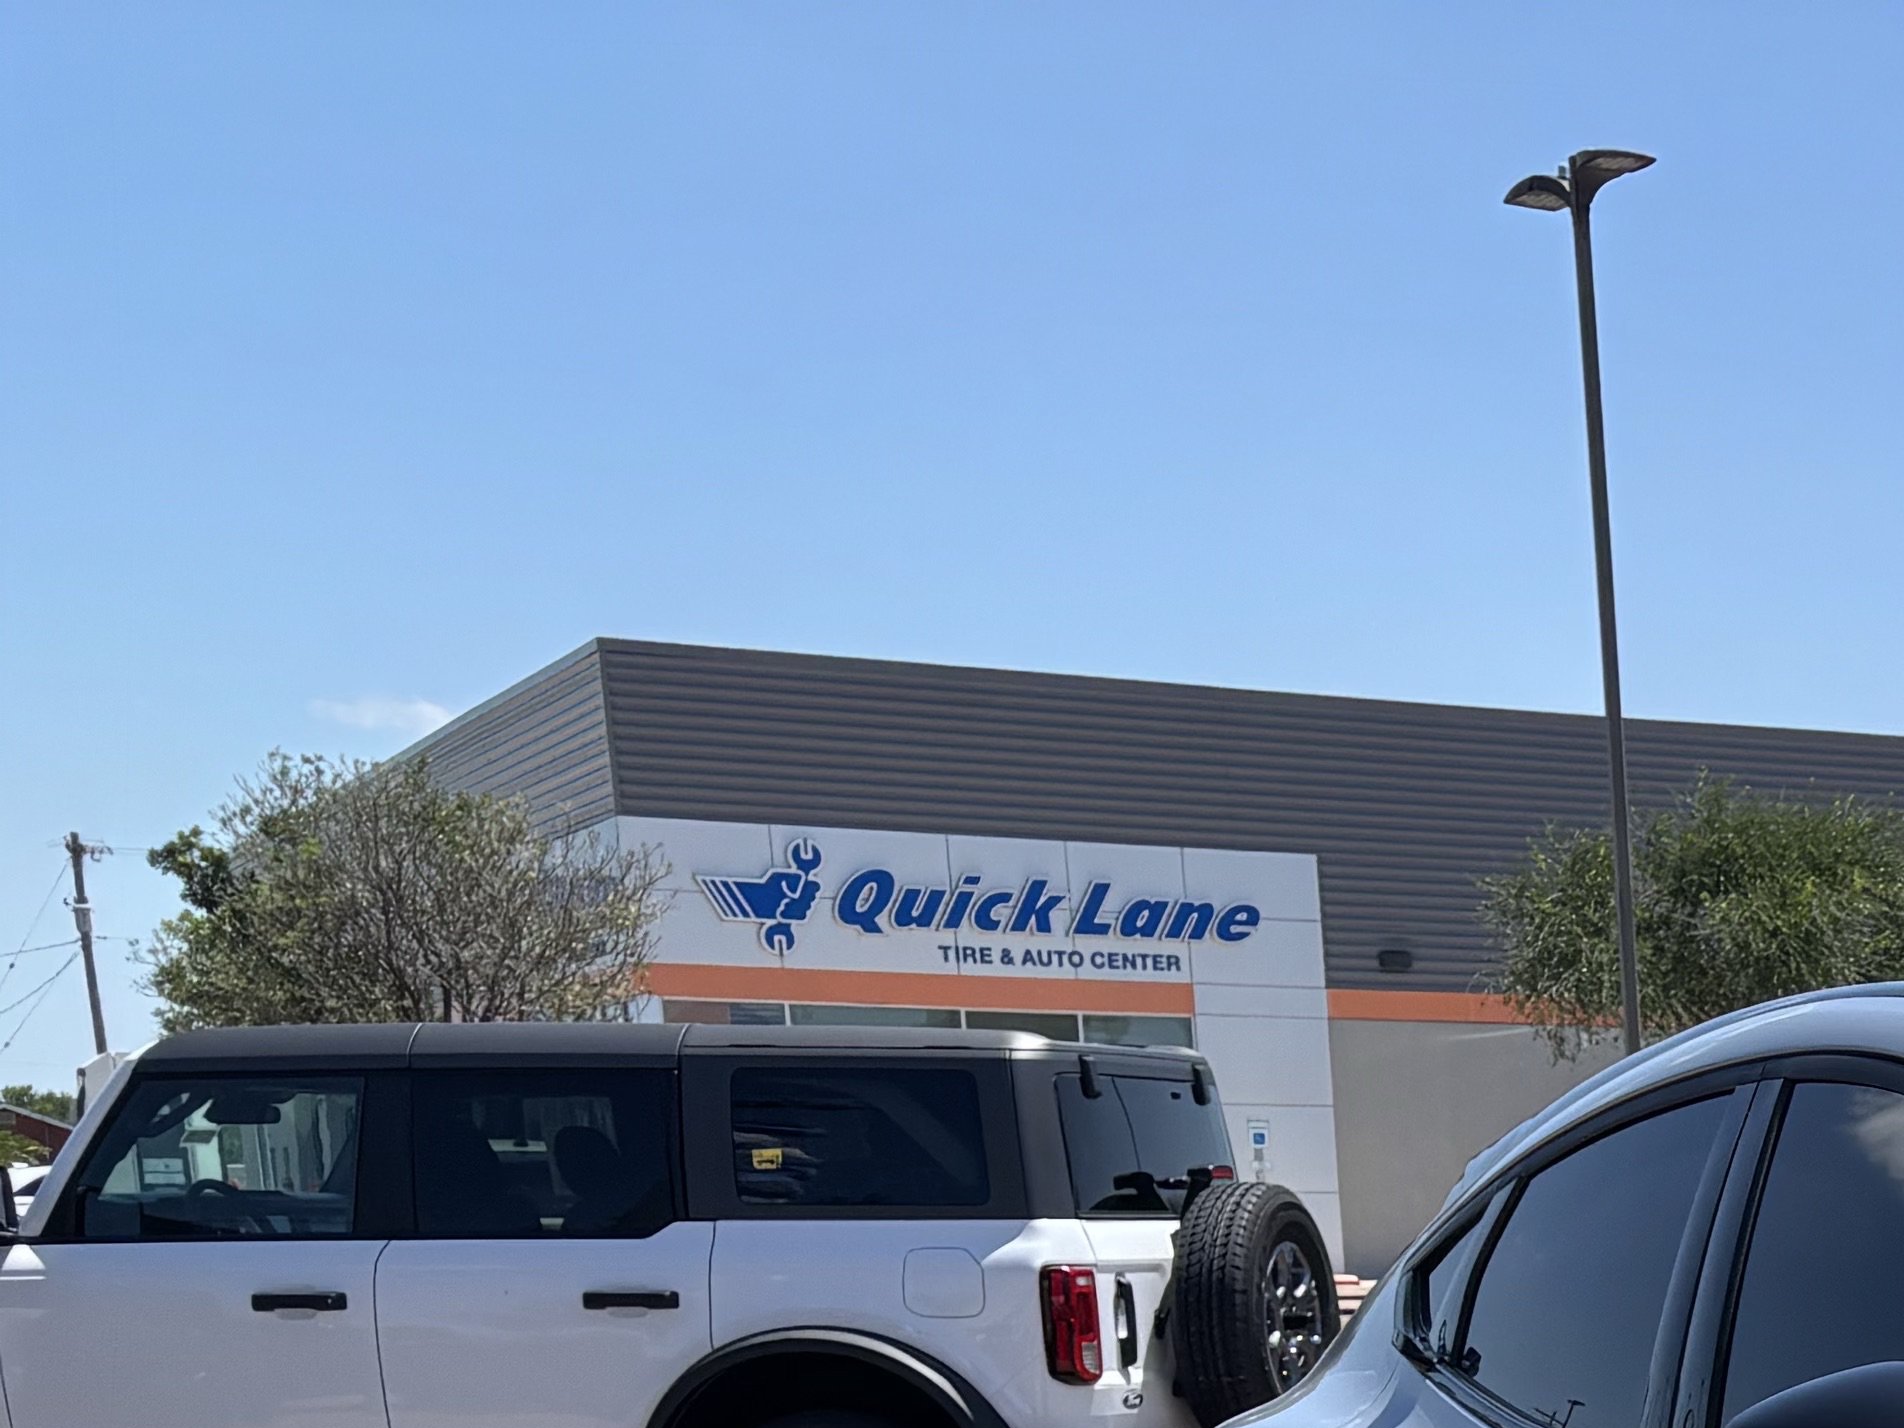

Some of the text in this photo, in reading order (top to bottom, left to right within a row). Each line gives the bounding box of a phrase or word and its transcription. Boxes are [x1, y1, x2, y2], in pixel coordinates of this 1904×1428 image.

[837, 868, 1261, 942] Quick Lane
[937, 945, 1182, 972] TIRE & AUTO CENTER
